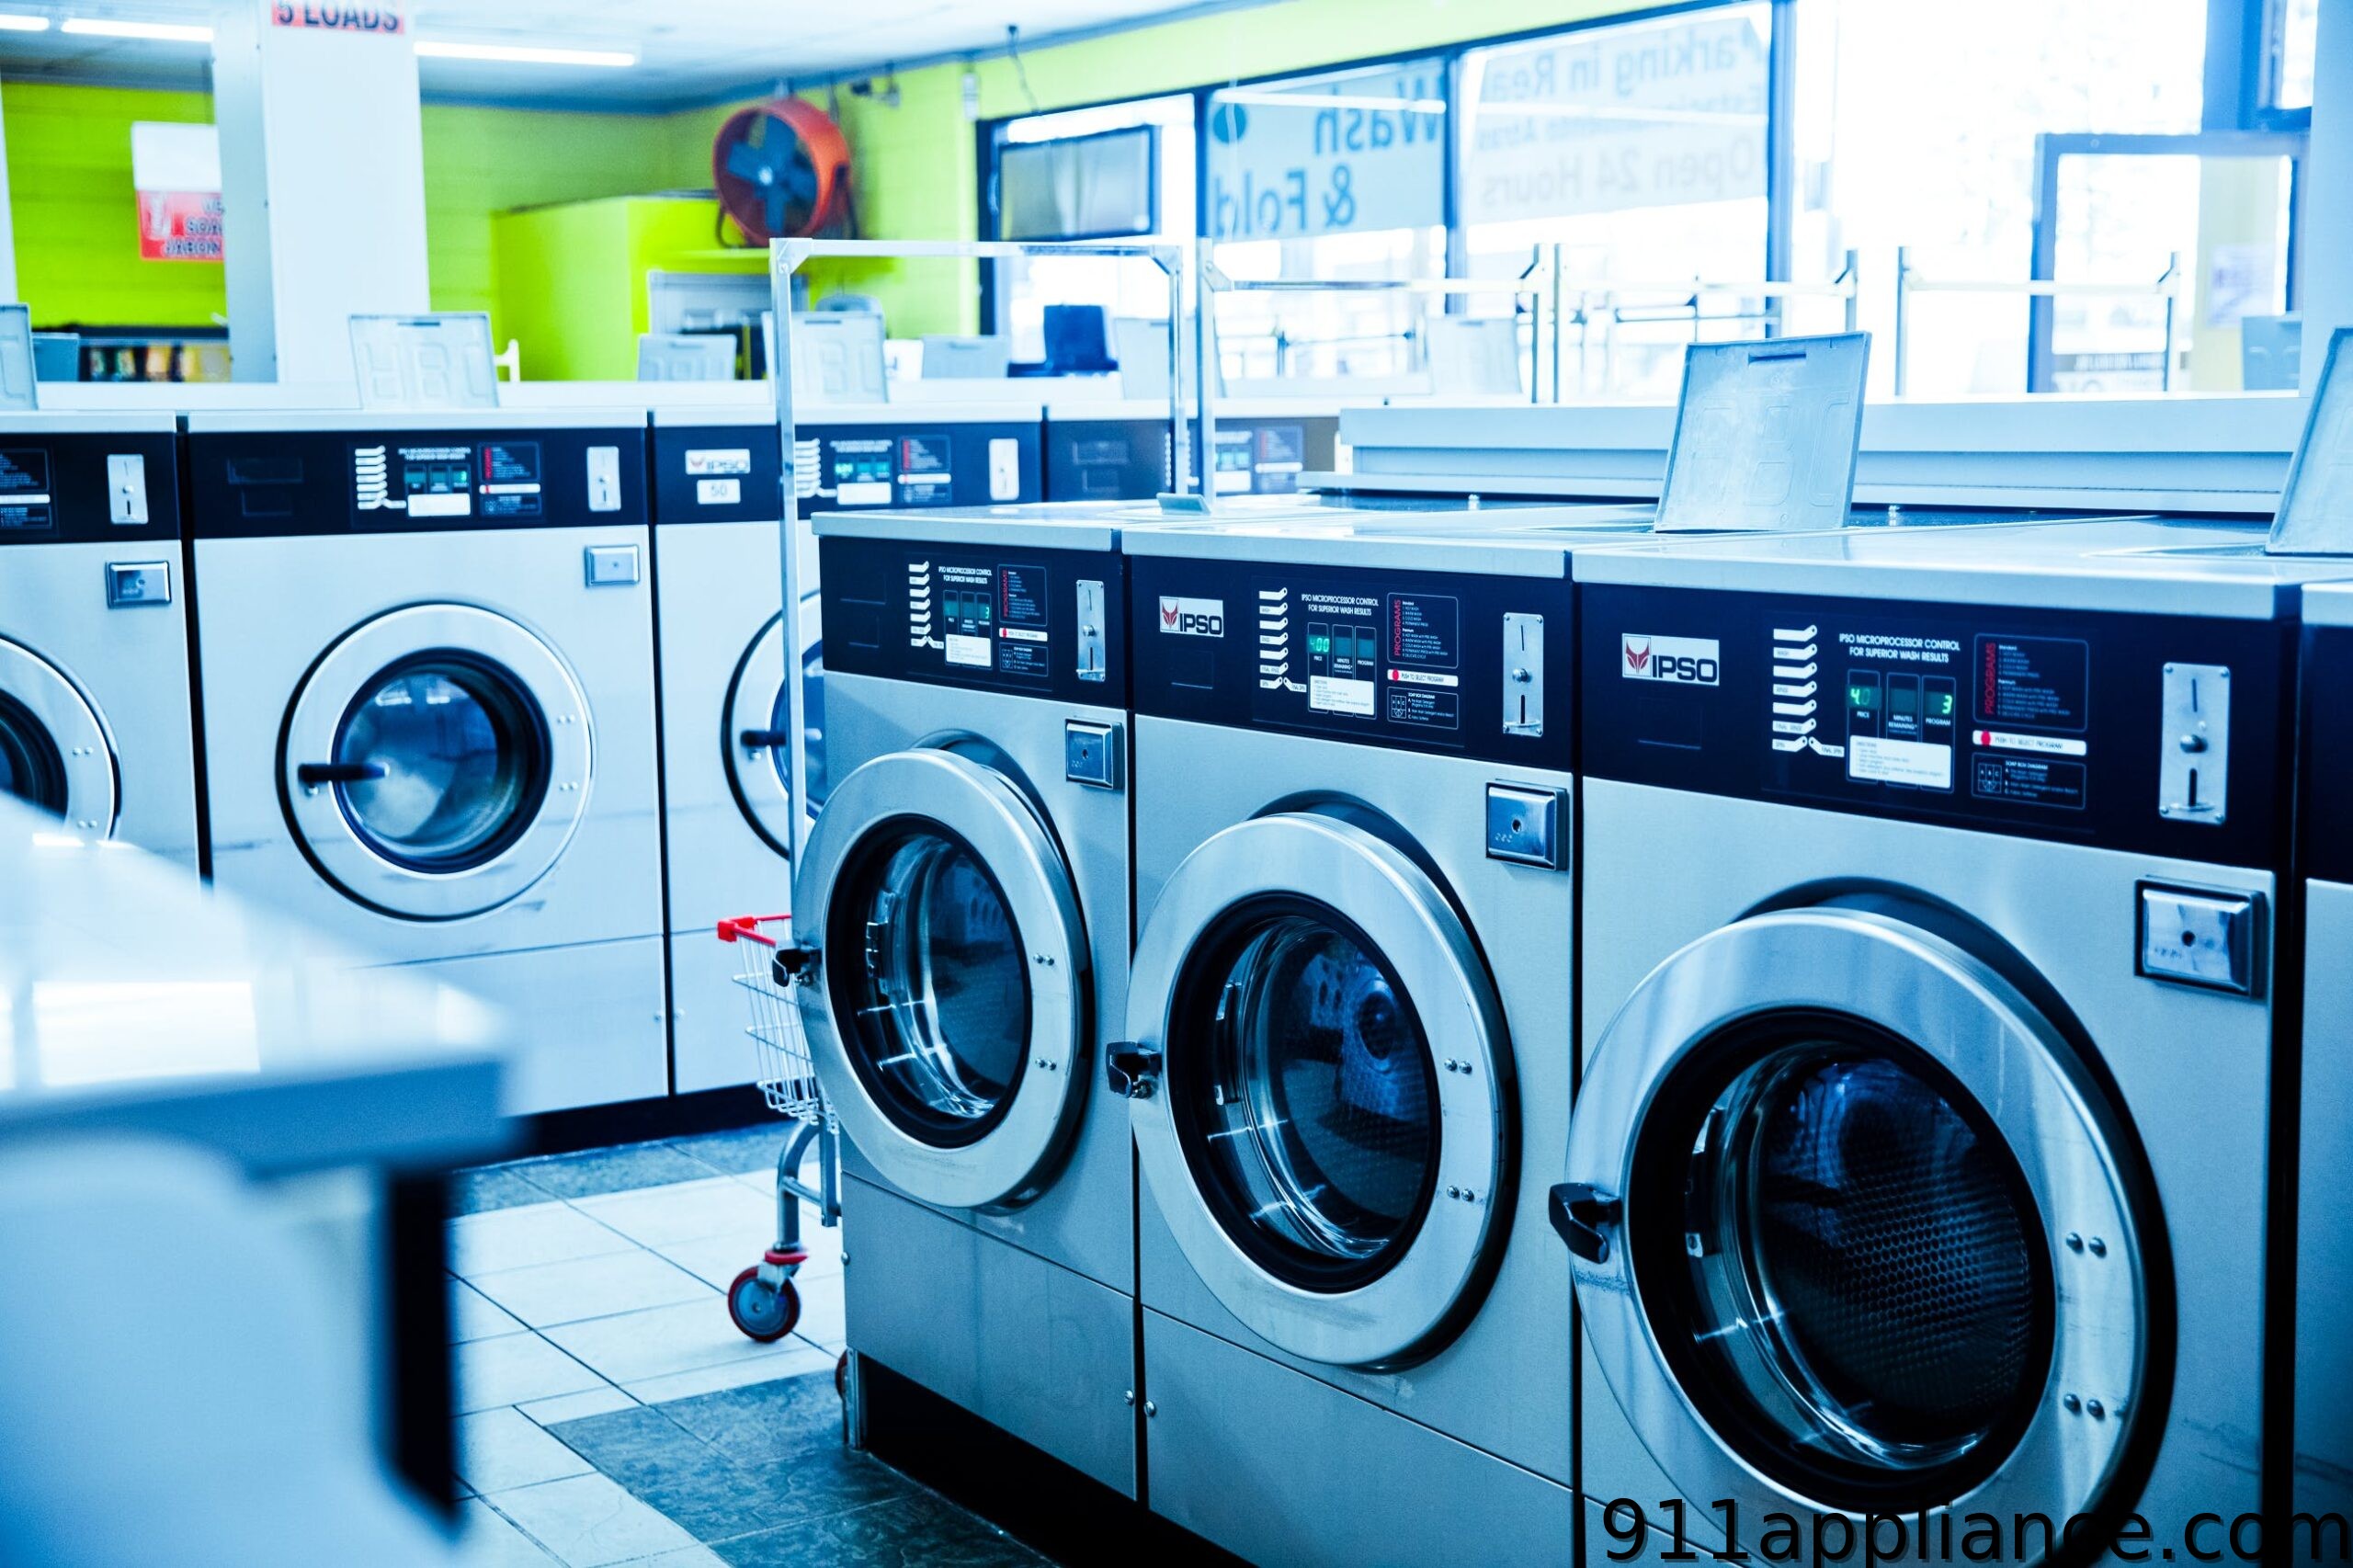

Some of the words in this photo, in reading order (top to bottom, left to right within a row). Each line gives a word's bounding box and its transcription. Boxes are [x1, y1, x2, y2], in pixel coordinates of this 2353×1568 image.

[1308, 604, 1318, 612] FOR
[1318, 605, 1339, 614] SUPERIOR
[1339, 607, 1354, 615] WASH
[1313, 594, 1356, 605] MICROPROCESSOR
[1356, 597, 1379, 607] CONTROL
[1179, 612, 1222, 635] IPSO
[1839, 632, 1855, 643] IPSO
[1856, 634, 1924, 648] MICROPROCESSOR
[1924, 639, 1961, 652] CONTROL
[1849, 646, 1864, 656] FOR
[1865, 648, 1898, 659] SUPERIOR
[1899, 650, 1920, 661] WASH
[1921, 651, 1949, 664] RESULTS
[1652, 654, 1718, 683] IPSO
[1942, 694, 1953, 715] 3
[1925, 717, 1951, 728] PROGRAM
